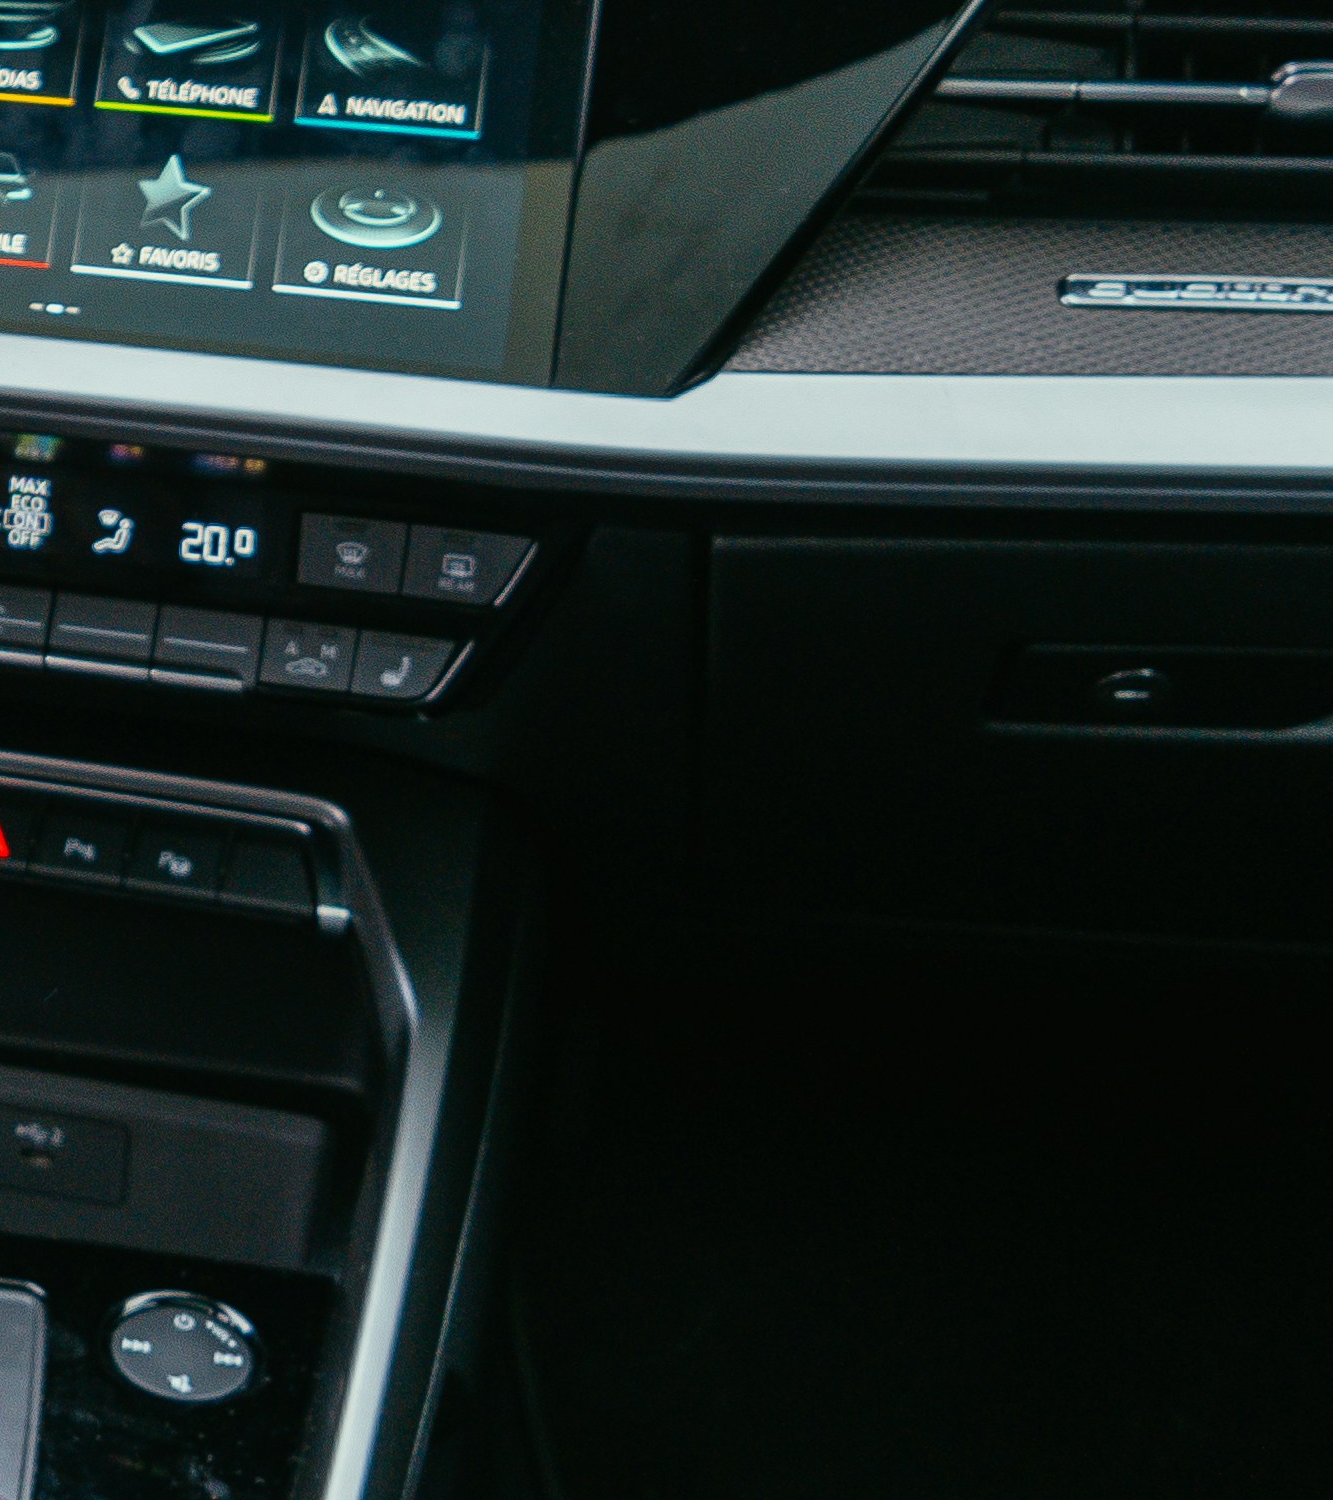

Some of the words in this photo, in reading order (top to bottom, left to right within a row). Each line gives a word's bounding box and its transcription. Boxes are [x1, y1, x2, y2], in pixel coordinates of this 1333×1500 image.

[147, 78, 259, 109] TÉLÉPHONE
[346, 97, 465, 125] NAVIGATION
[139, 246, 220, 272] FAVORIS
[334, 260, 437, 293] RÉGLAGES
[8, 476, 51, 496] MAX
[10, 495, 46, 512] ECO
[14, 513, 41, 531] ON
[7, 531, 44, 549] OFF
